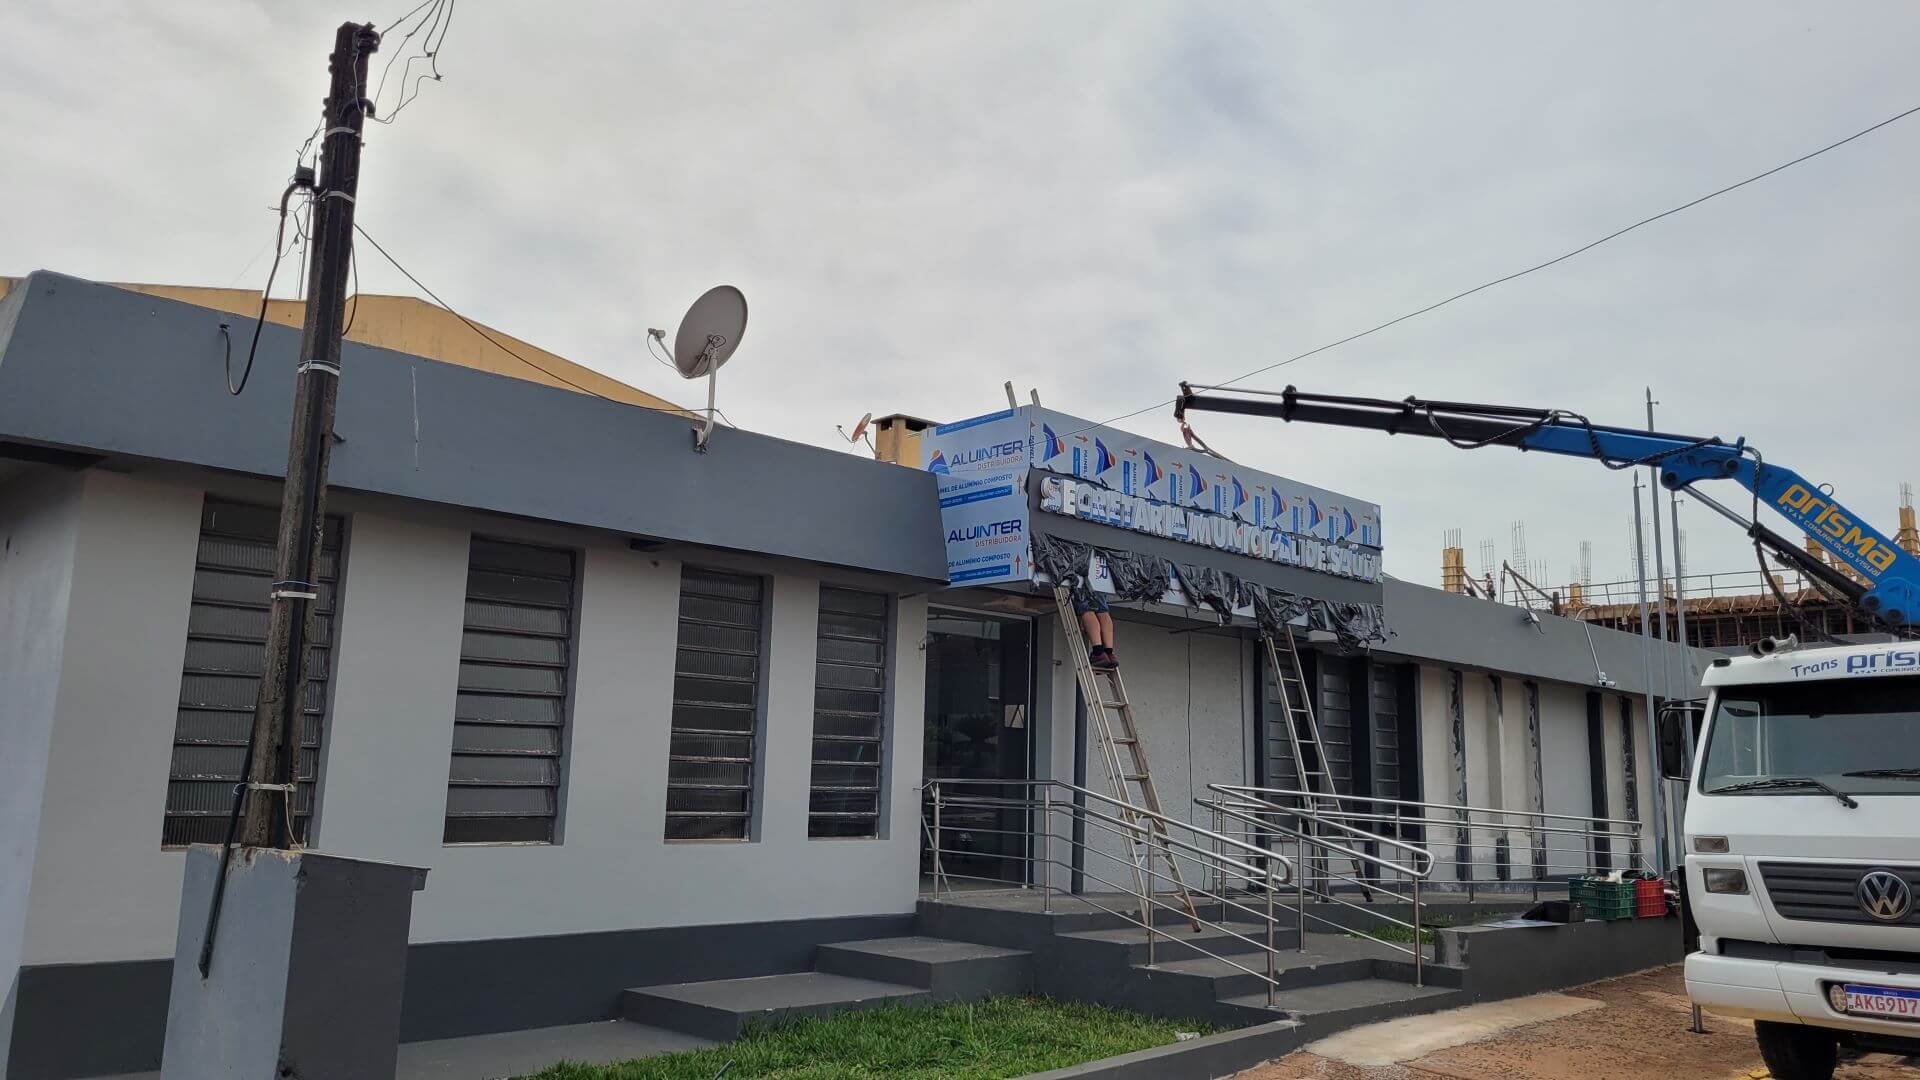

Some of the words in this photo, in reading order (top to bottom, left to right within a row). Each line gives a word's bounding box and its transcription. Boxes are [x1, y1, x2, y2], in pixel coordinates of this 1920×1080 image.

[951, 439, 1024, 468] ALUINTER
[977, 455, 1023, 471] DISTRIBUIDORA
[984, 473, 1013, 484] COMPOSTO
[1039, 476, 1188, 541] SECRETARIA
[1187, 511, 1301, 566] MUNICIPAL
[948, 519, 1022, 543] ALUINTER
[975, 535, 1022, 548] DISTRIBUIDORA
[982, 553, 1011, 563] COMPOSTO
[1790, 659, 1838, 678] Trans
